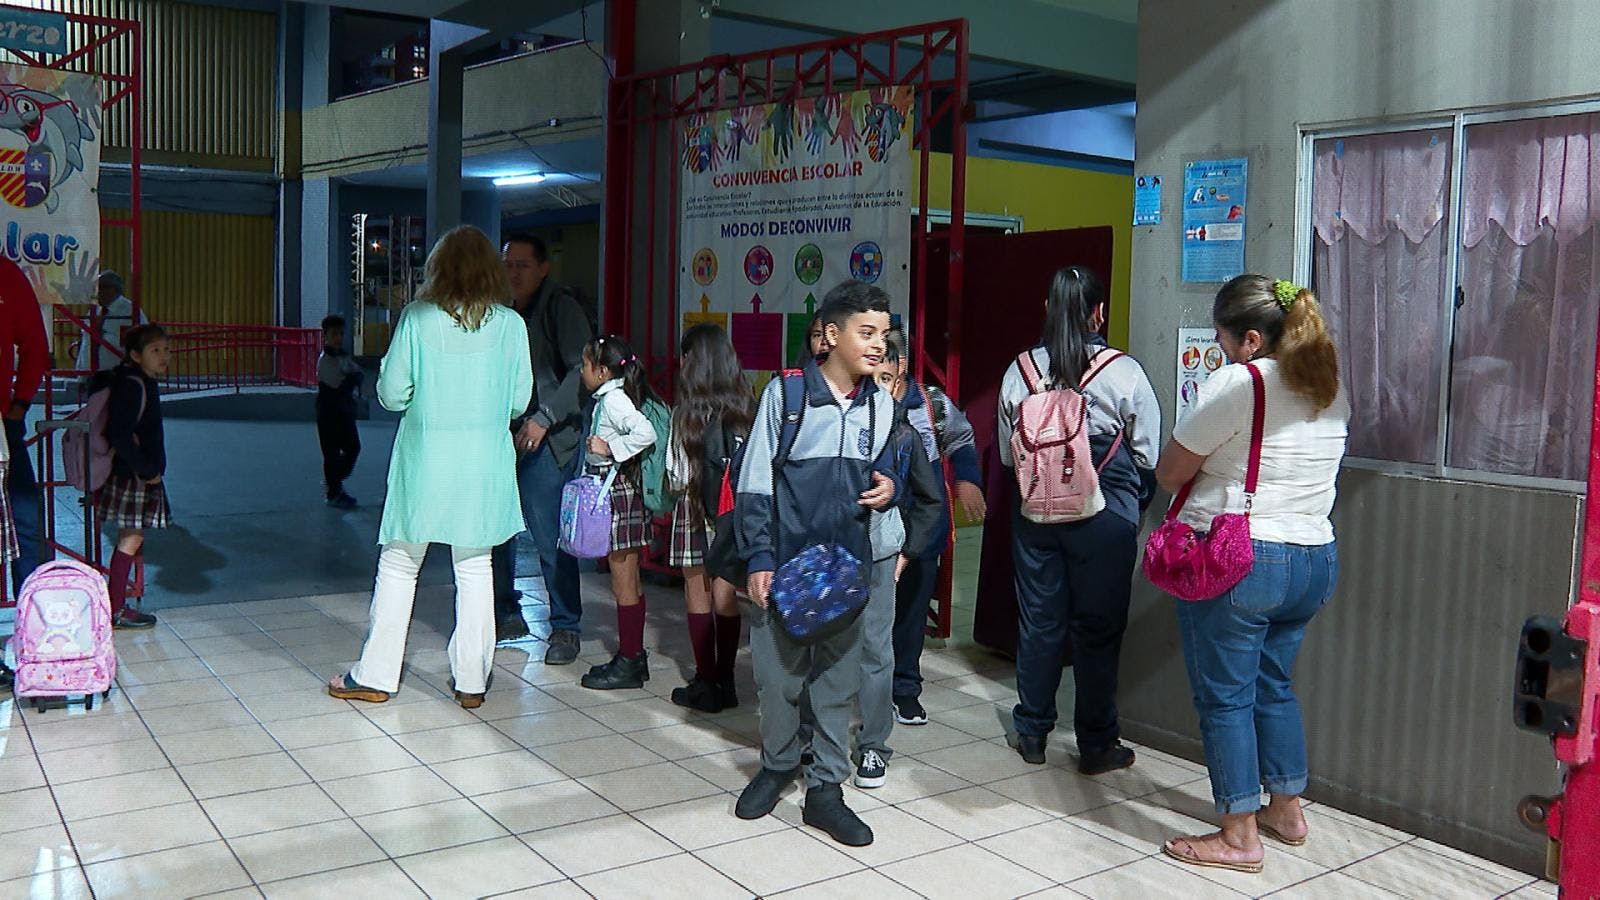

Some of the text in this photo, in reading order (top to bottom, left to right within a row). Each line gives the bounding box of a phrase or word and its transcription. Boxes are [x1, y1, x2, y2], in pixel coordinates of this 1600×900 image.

[802, 161, 863, 180] ESCOLAR
[818, 194, 831, 202] entre
[886, 188, 896, 197] de
[897, 188, 904, 197] la
[853, 200, 862, 208] de
[863, 200, 870, 208] la
[721, 217, 851, 238] MODOS DE CONVIVIR
[0, 221, 80, 266] lar
